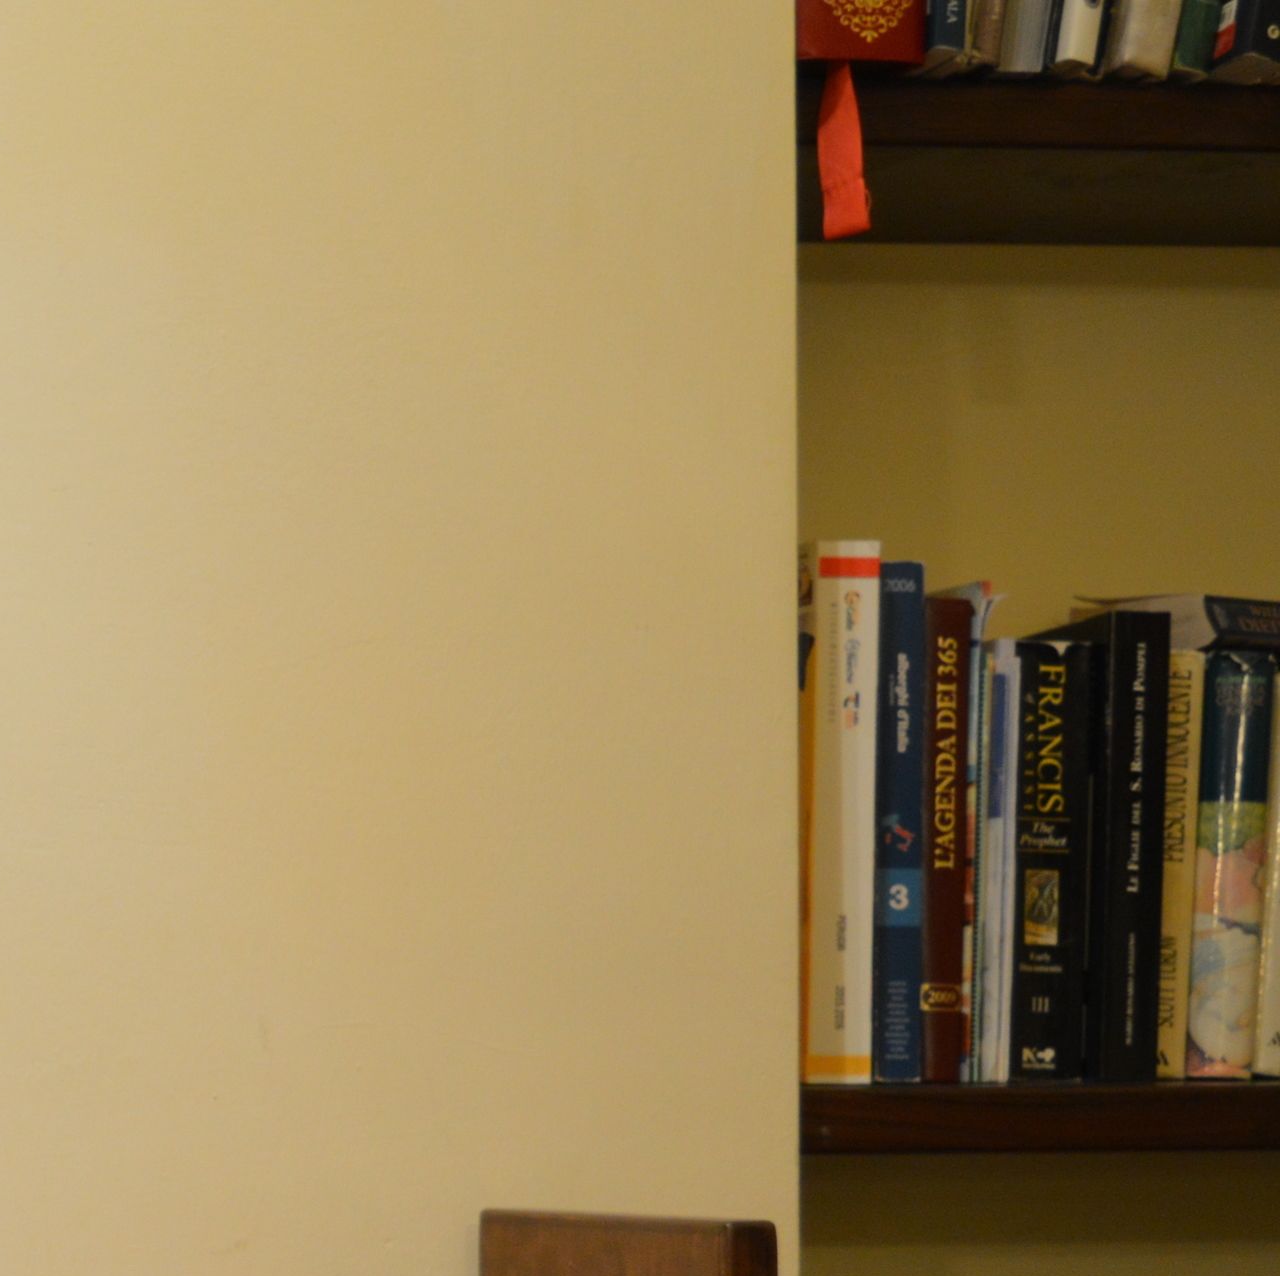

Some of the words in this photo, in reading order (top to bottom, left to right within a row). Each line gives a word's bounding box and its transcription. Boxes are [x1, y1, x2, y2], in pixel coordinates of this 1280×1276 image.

[884, 579, 916, 592] 2006
[936, 636, 958, 676] 365
[934, 682, 958, 731] DEI
[1036, 663, 1066, 814] FRANCIS
[933, 735, 958, 870] L'AGENDA
[888, 883, 910, 911] 3
